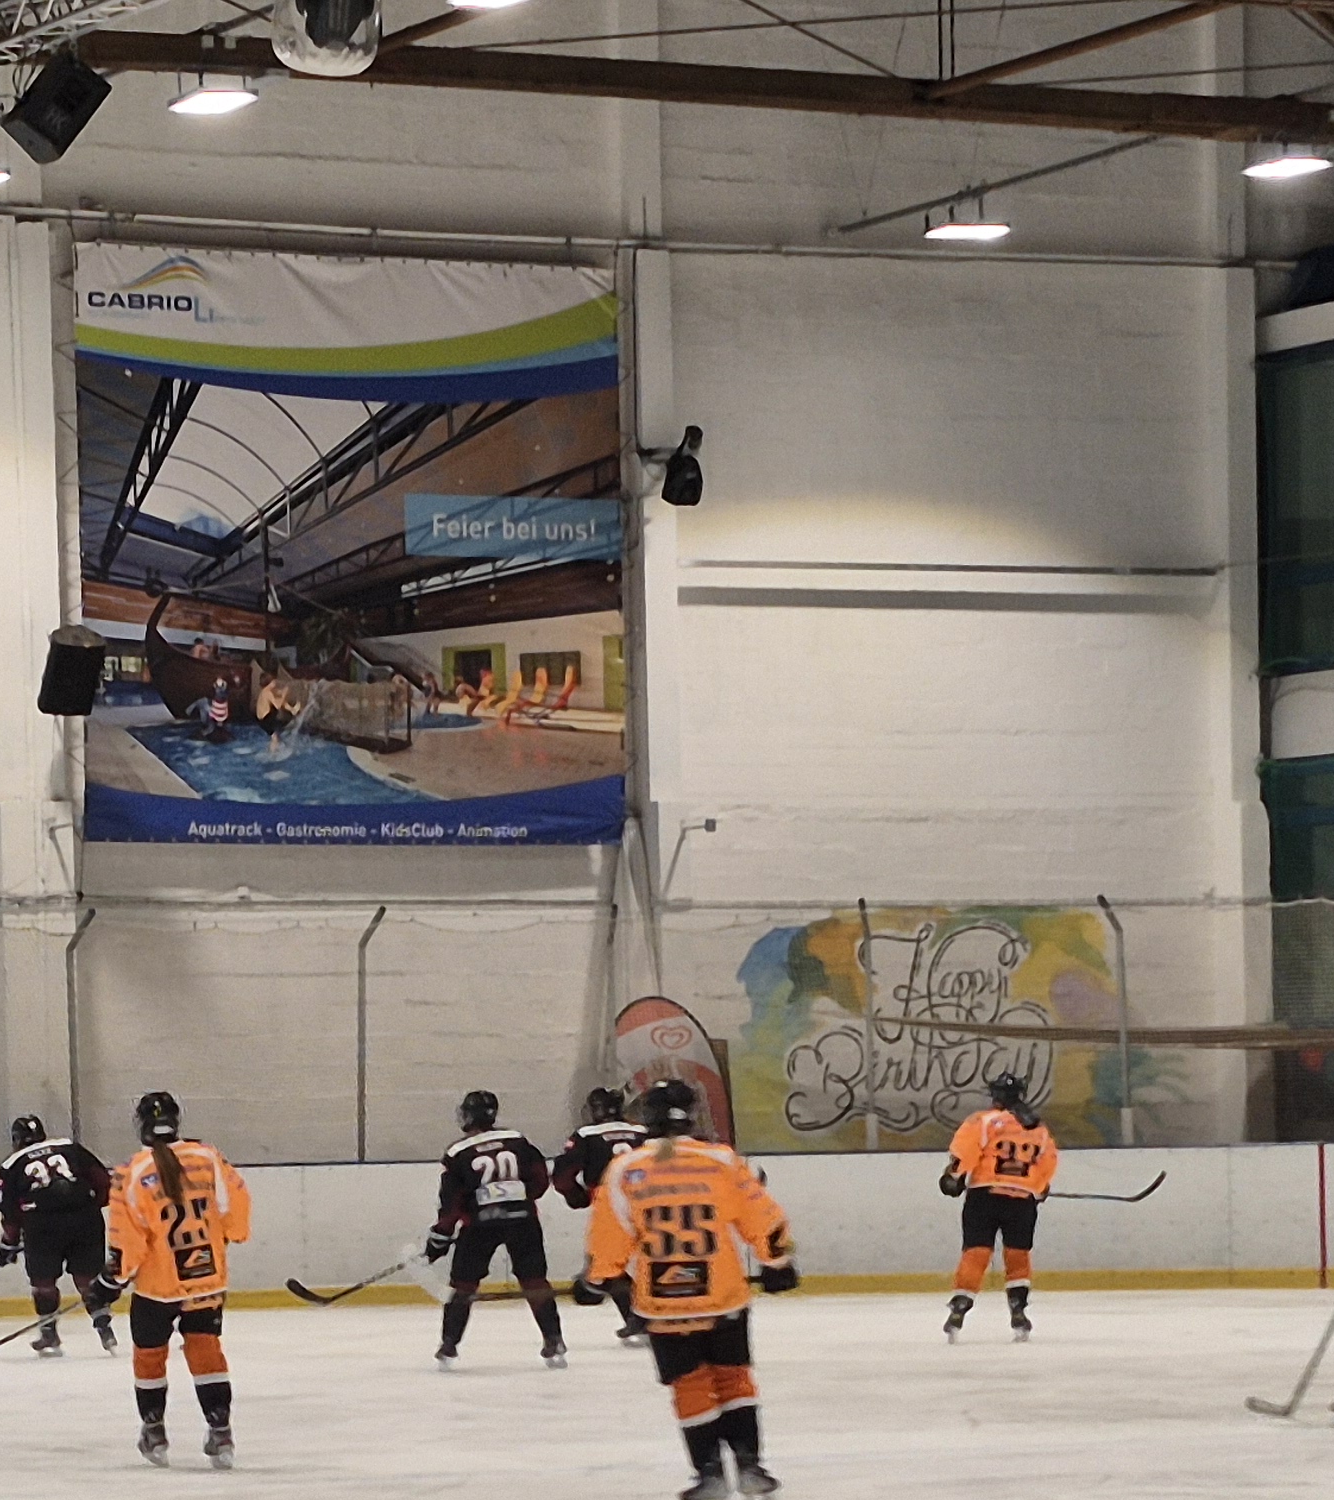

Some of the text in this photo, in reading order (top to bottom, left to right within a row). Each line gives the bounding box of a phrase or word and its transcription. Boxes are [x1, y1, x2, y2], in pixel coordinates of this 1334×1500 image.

[87, 290, 193, 312] CABRIO
[432, 513, 597, 542] Feier bei uns!
[188, 820, 263, 838] Aquatrack
[276, 821, 367, 838] Gastronomie
[381, 822, 444, 838] KidsClub
[456, 823, 528, 838] Animation
[471, 1150, 519, 1186] 20
[641, 1203, 717, 1258] 55
